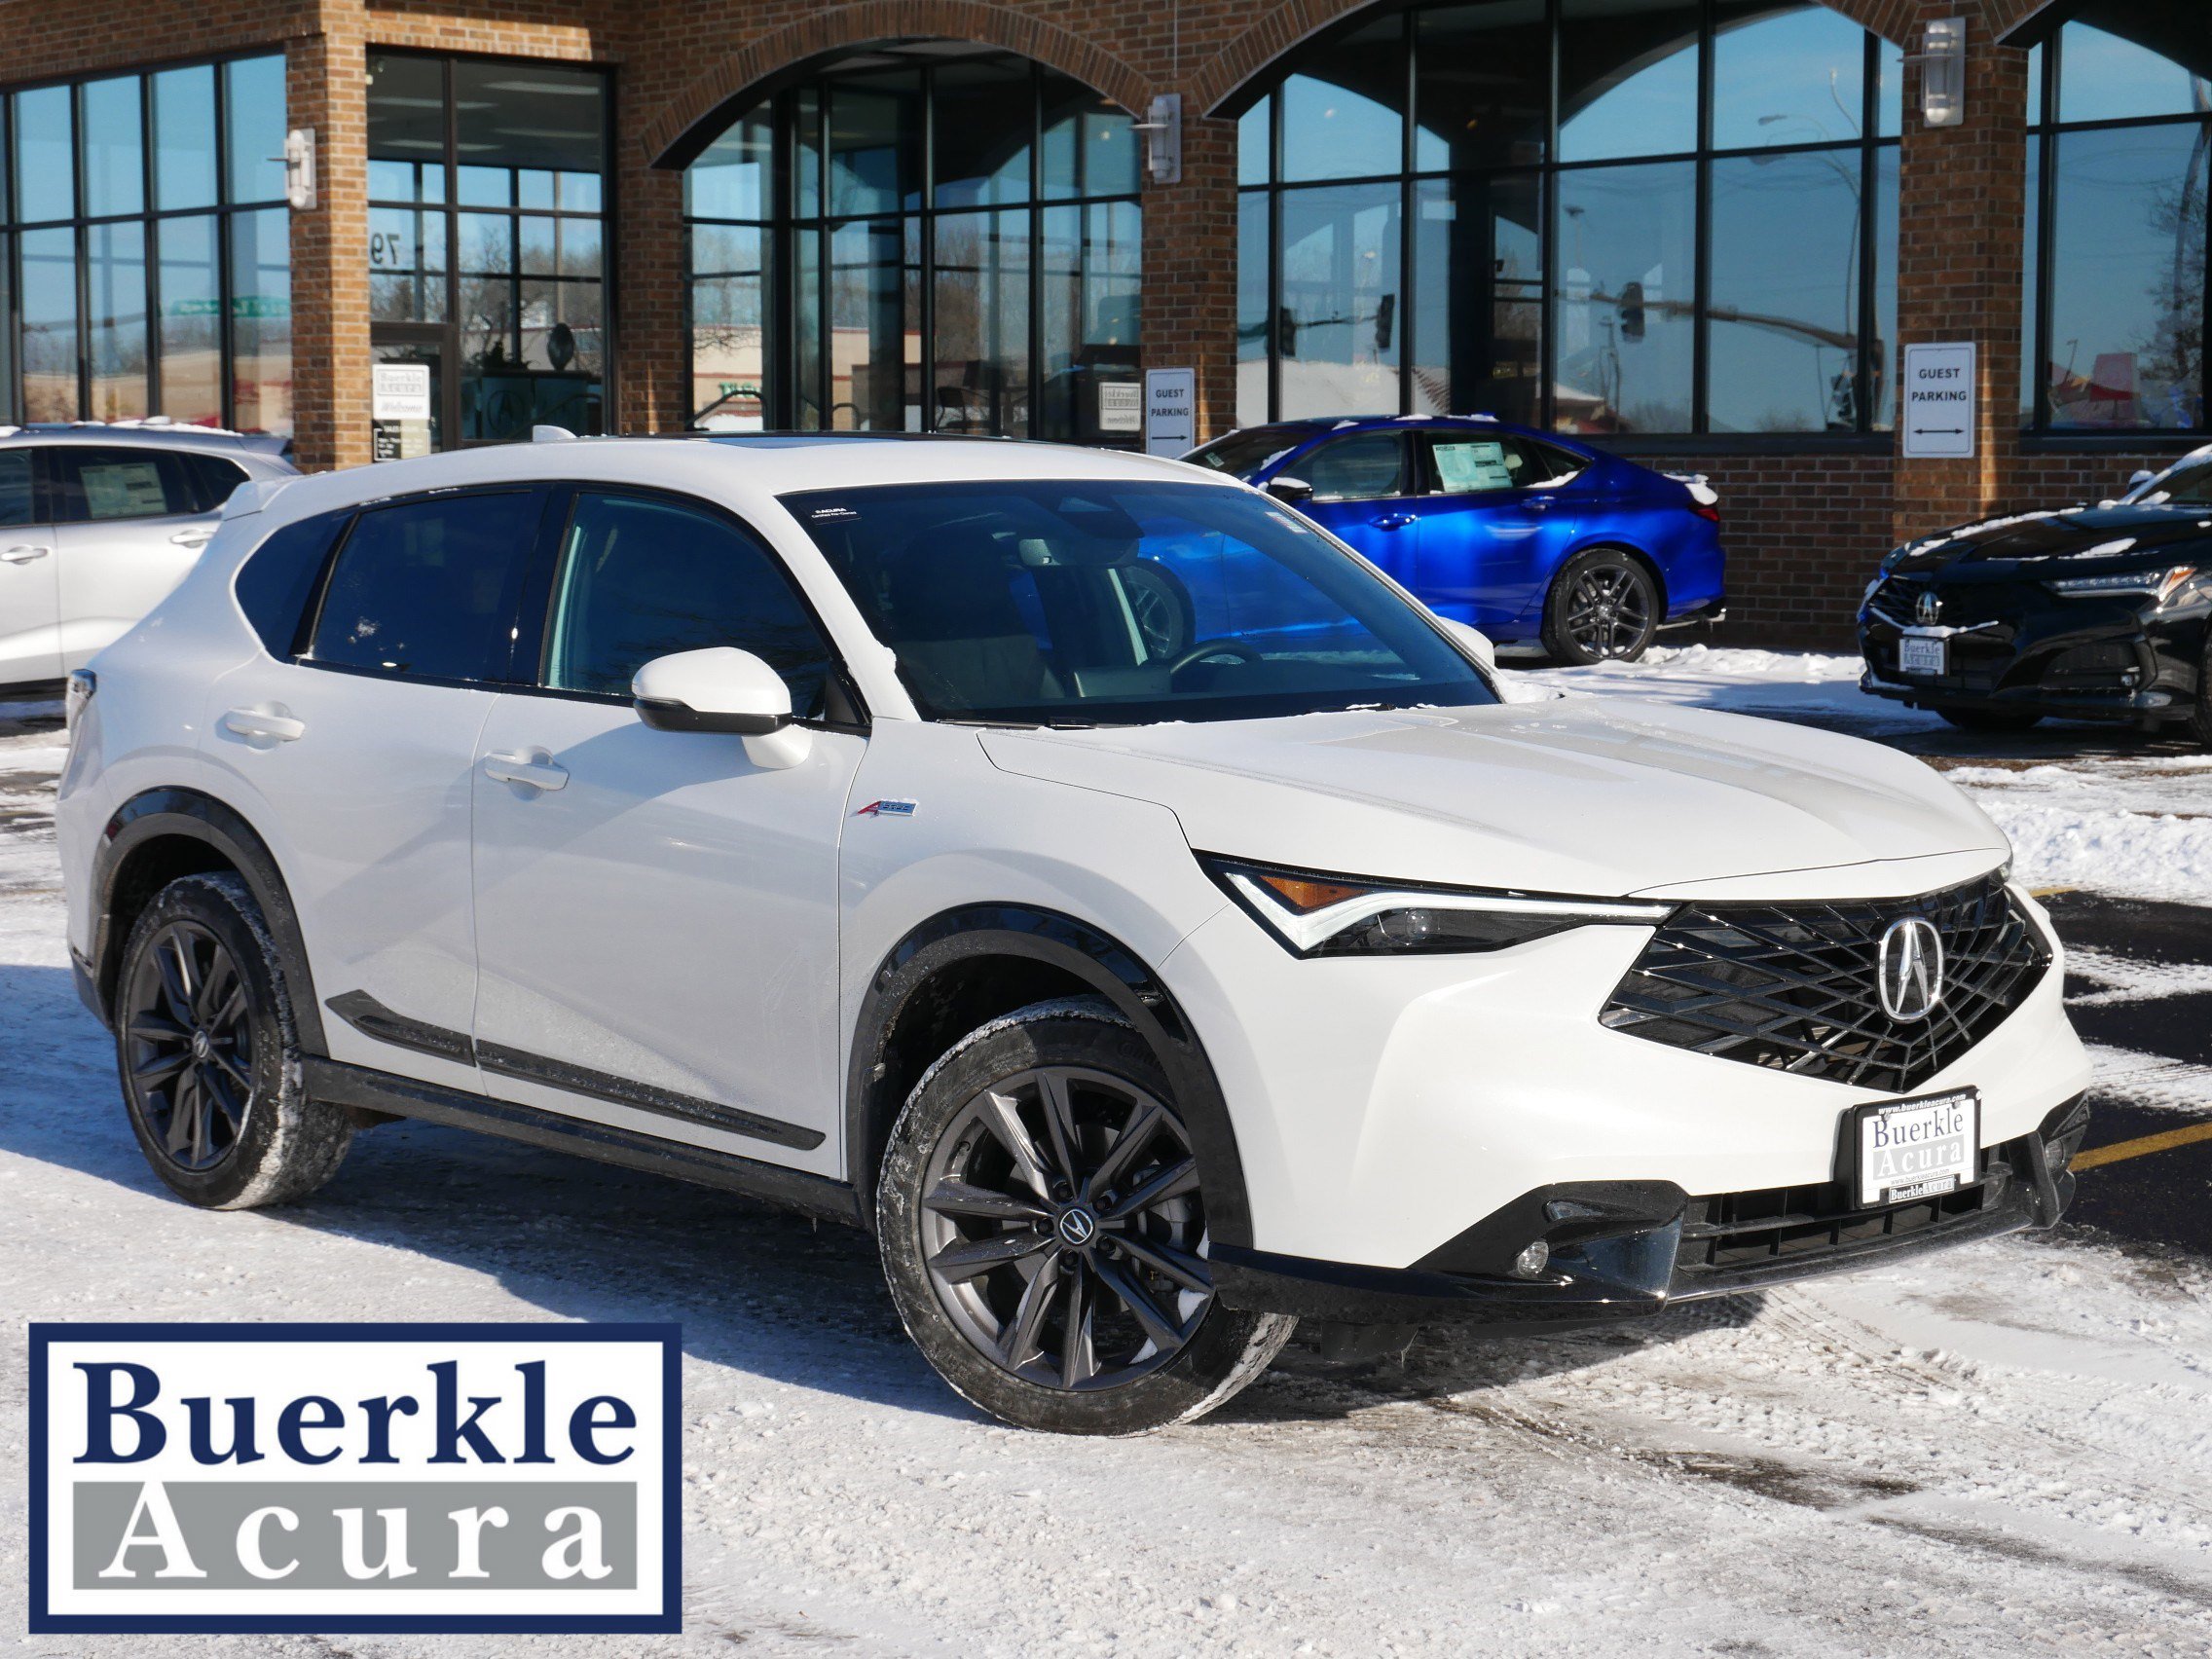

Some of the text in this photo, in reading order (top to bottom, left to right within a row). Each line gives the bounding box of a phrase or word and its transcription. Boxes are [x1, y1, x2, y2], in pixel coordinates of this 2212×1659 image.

[1918, 368, 1961, 380] GUEST
[1156, 388, 1185, 399] GUEST
[1911, 390, 1968, 402] PARKING
[1151, 407, 1189, 418] PARKING
[1878, 1093, 1967, 1116] www.buerkleacura.com
[1872, 1107, 1964, 1149] Buerkle
[1876, 1141, 1962, 1177] Acura
